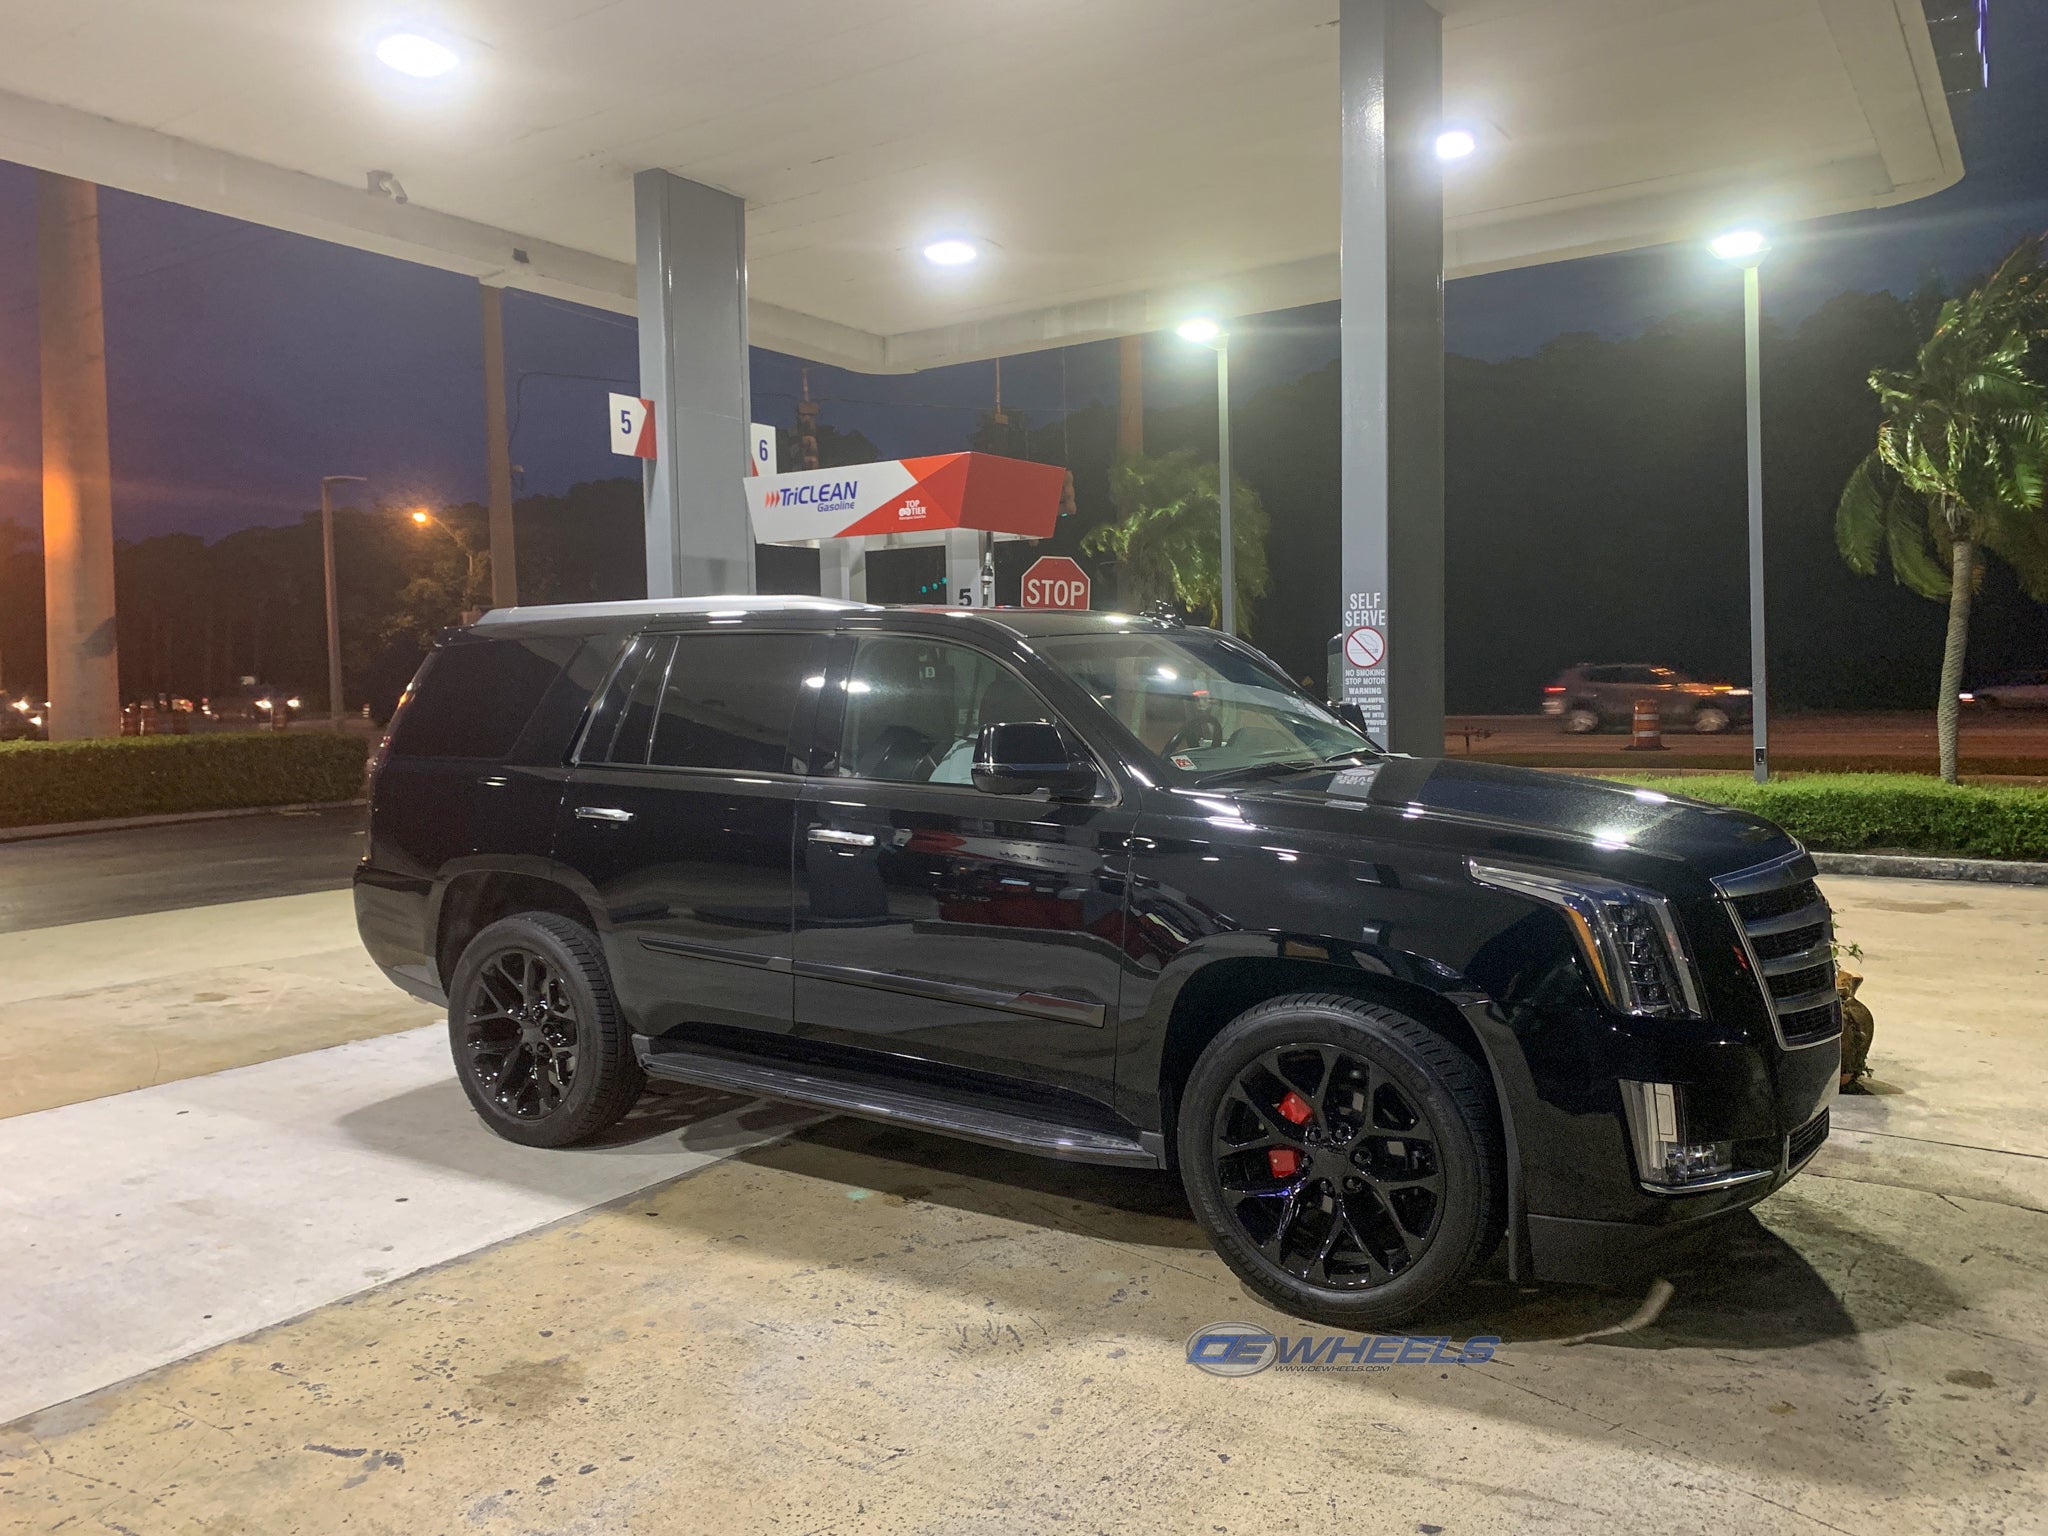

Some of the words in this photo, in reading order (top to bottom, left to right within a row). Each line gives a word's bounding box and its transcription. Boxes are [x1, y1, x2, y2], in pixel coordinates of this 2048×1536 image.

[620, 410, 632, 435] 5
[759, 439, 769, 461] 6
[780, 480, 858, 507] TriCLEAN
[817, 501, 855, 513] Gasoline
[904, 499, 920, 508] TOP
[911, 506, 926, 515] TIER
[958, 588, 972, 606] 5
[1026, 579, 1085, 607] STOP
[1350, 592, 1380, 610] SELF
[1344, 609, 1386, 627] SERVE
[1345, 669, 1355, 677] NO
[1356, 669, 1385, 677] SMOKING
[1345, 677, 1361, 685] STOP
[1362, 677, 1386, 685] MOTOR
[1348, 687, 1382, 695] WARNING
